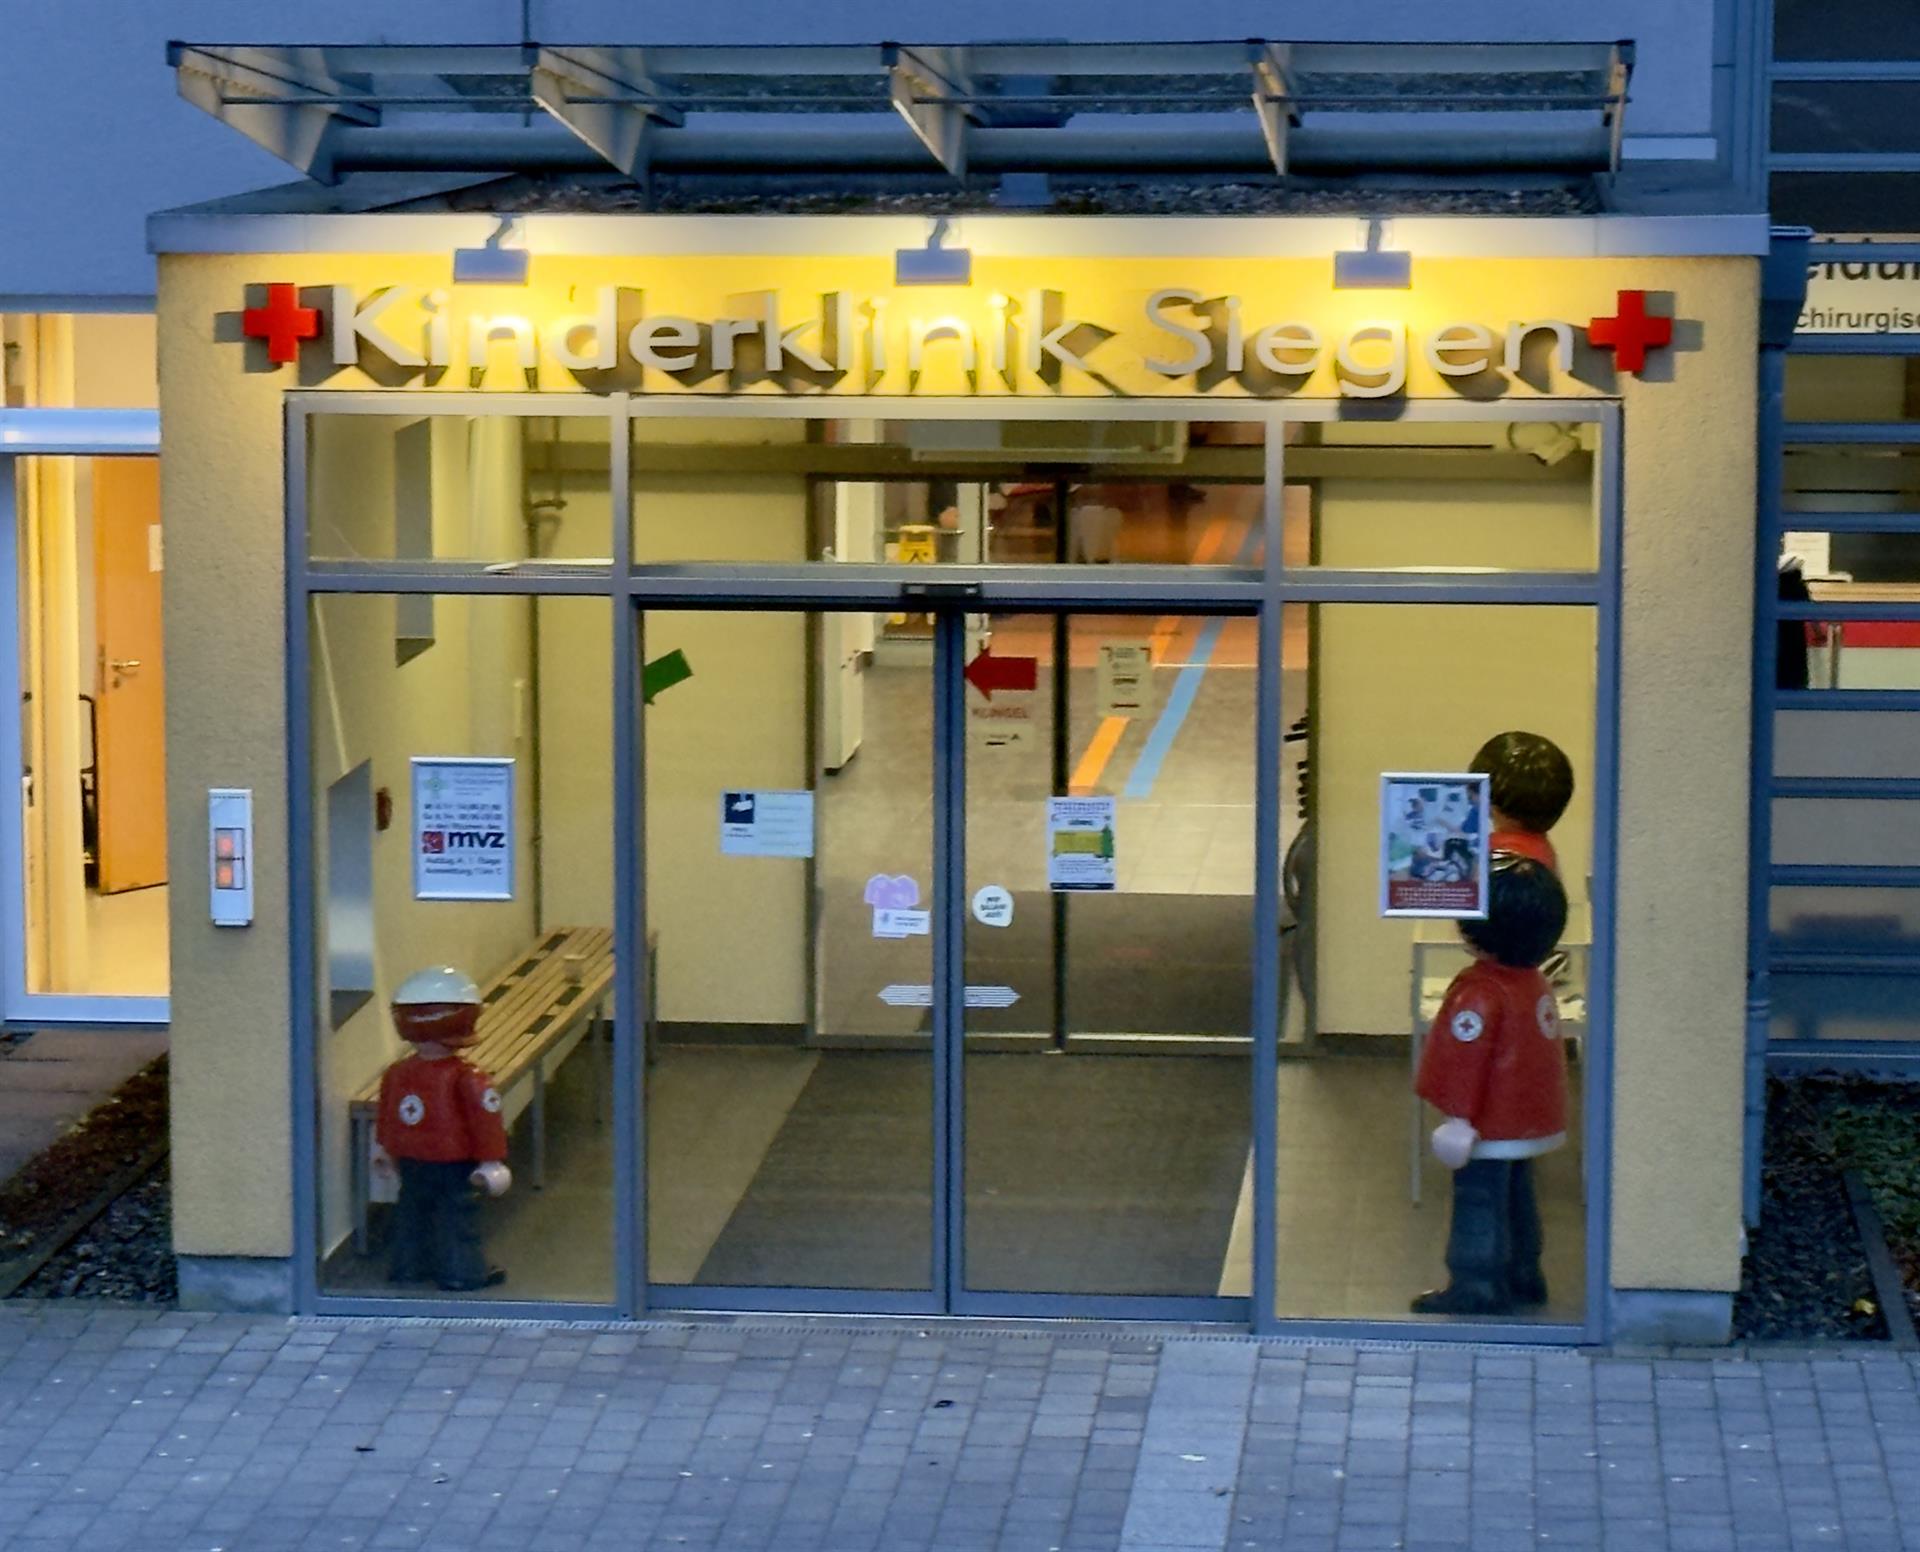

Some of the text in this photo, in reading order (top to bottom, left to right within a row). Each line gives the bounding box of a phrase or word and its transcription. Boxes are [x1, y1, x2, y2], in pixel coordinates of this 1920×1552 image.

[1797, 307, 1920, 333] chirurgis
[331, 284, 1575, 398] Kinderklinik Siegen
[448, 832, 505, 849] mvz
